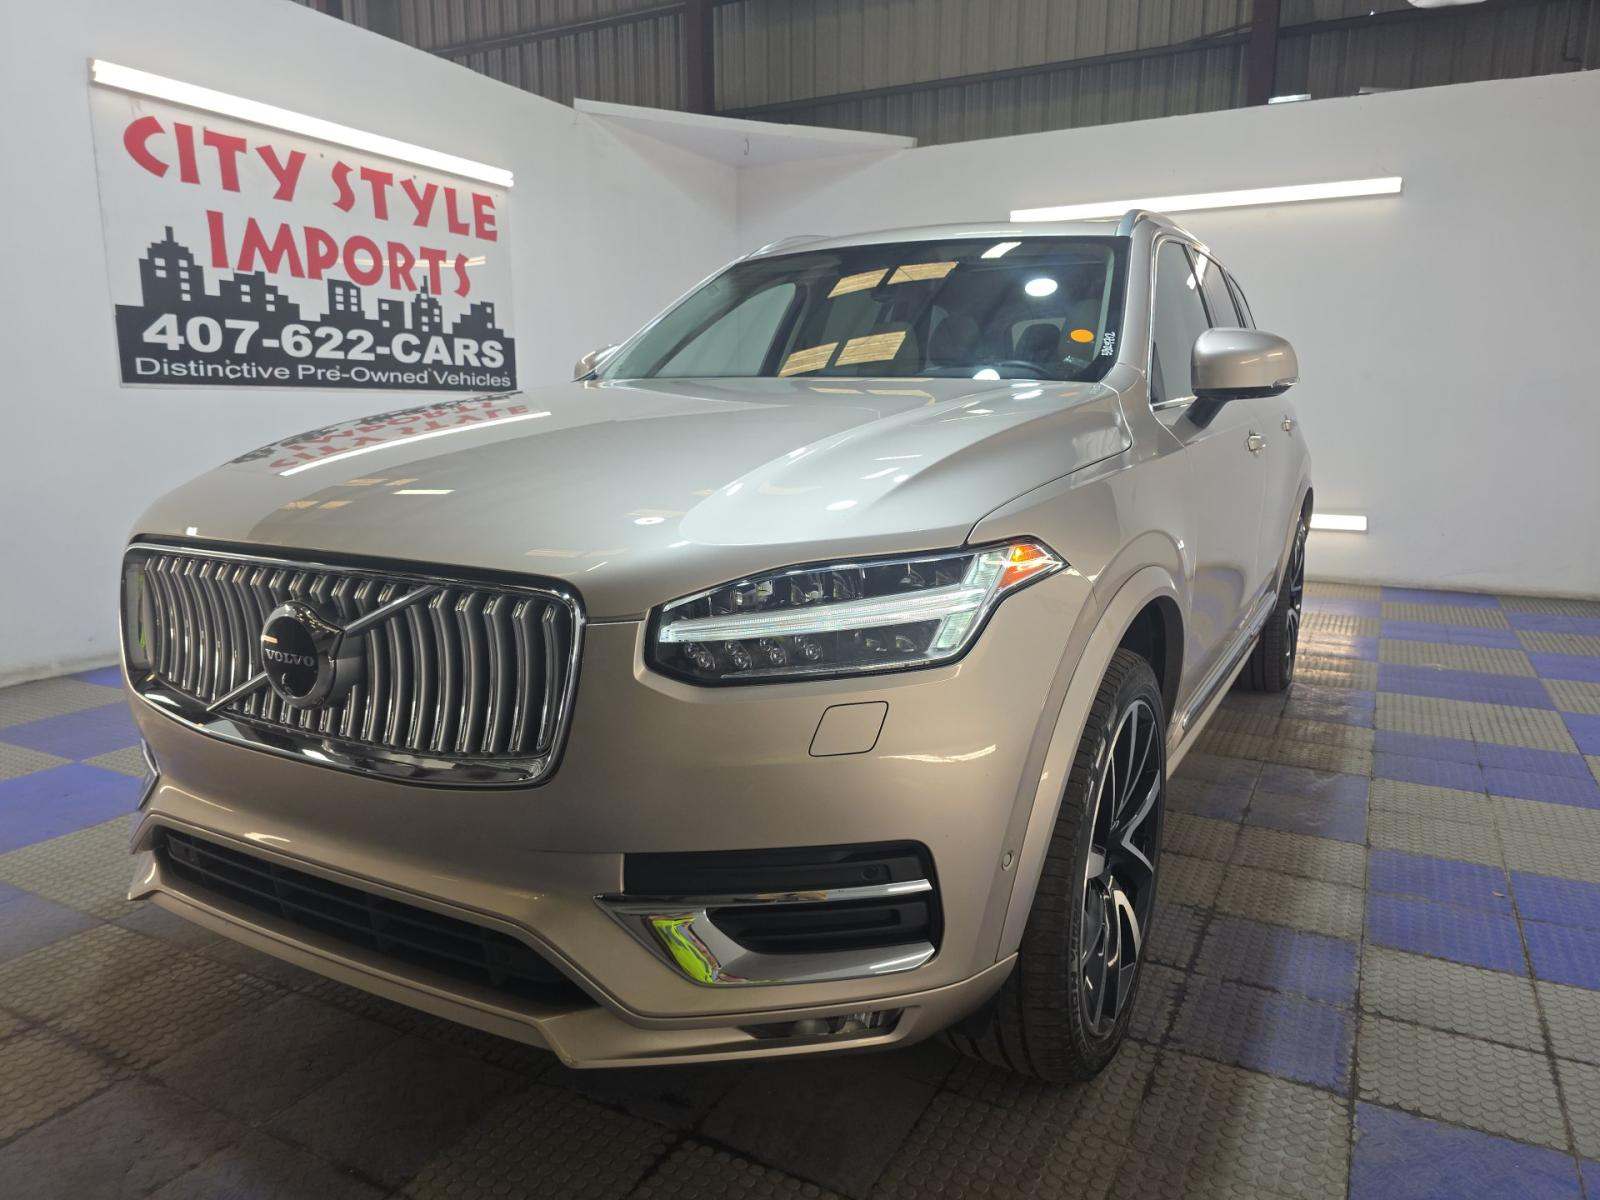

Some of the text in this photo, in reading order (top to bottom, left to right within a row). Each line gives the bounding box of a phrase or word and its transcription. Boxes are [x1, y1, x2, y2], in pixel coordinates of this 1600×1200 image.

[123, 115, 498, 242] CITY STYLE
[206, 209, 471, 297] IMPORTS
[142, 313, 505, 368] 407-622-CARS
[134, 357, 511, 387] Distinctive Pre-Owned Vehicles
[265, 648, 314, 667] VOLVO
